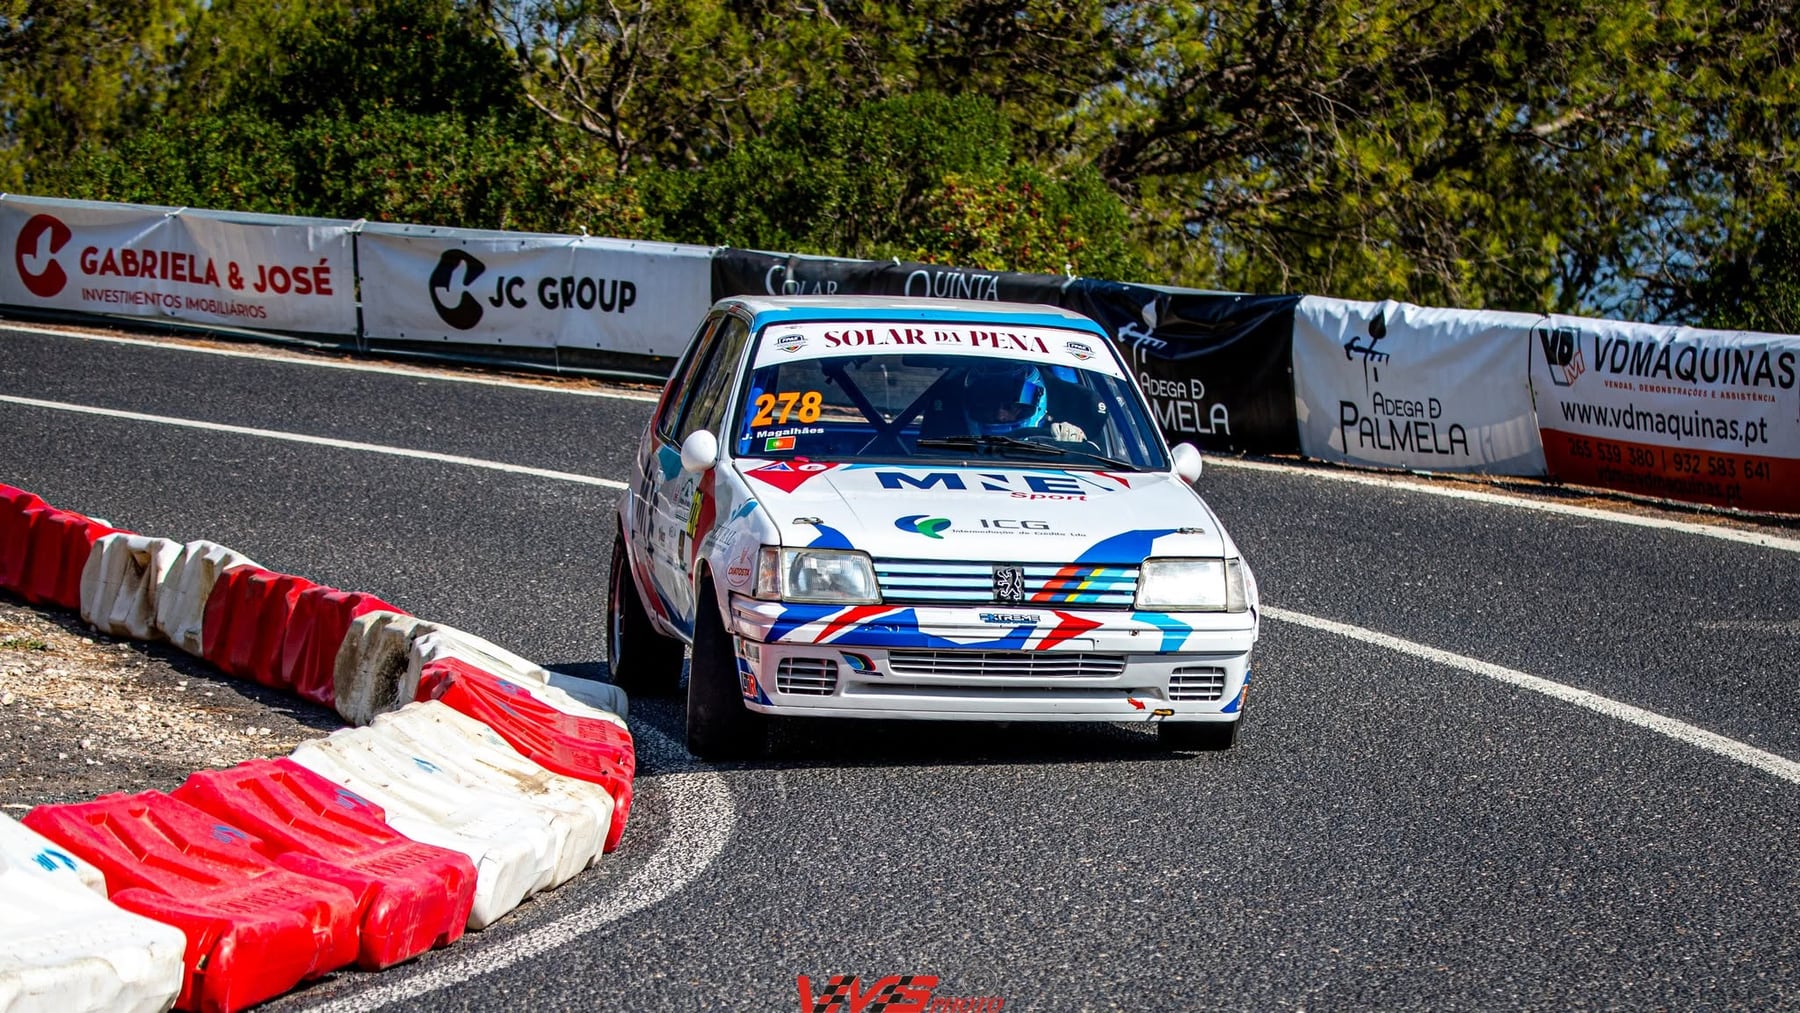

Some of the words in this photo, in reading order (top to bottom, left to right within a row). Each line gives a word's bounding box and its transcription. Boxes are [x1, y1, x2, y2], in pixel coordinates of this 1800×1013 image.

[80, 246, 221, 288] GABRIELA
[227, 261, 244, 290] &
[253, 258, 334, 296] JOSÉ
[904, 269, 999, 301] QUINTA
[81, 288, 182, 310] INVESTIMENTOS
[185, 296, 267, 319] IMOBILIÁRIOS
[488, 276, 527, 309] JC
[537, 275, 637, 313] GROUP
[824, 328, 927, 348] SOLAR
[935, 331, 962, 343] DA
[970, 330, 1050, 354] PENA
[1594, 335, 1795, 389] VDMÁQUINAS
[1140, 372, 1188, 398] ADEGA
[1604, 379, 1636, 392] VENDAS,
[1638, 384, 1708, 398] DEMONSTRAÇÕES
[1720, 389, 1776, 402] ASSISTÊNCIA
[750, 391, 822, 427] 278
[1152, 398, 1231, 436] MELA
[1373, 392, 1425, 418] ADEGA
[757, 427, 824, 438] Magalhães
[1340, 400, 1470, 456] PALMELA
[1561, 401, 1768, 447] www.vdmaquinas.pt
[1597, 441, 1622, 464] 539
[1629, 447, 1654, 468] 380
[1673, 453, 1701, 474] 932
[1708, 456, 1737, 478] 583
[1744, 460, 1771, 481] 641
[980, 519, 1050, 529] ICG
